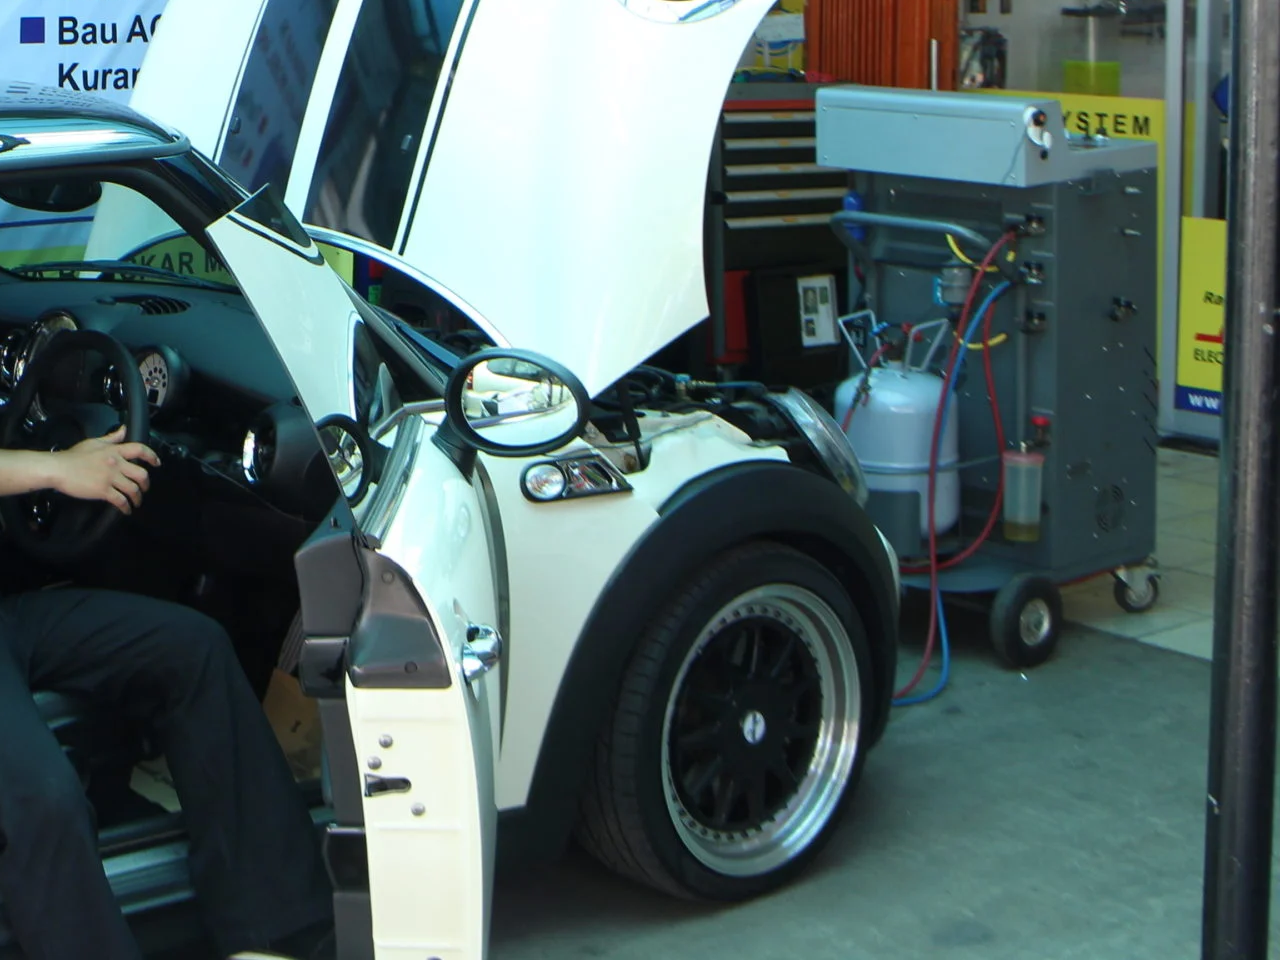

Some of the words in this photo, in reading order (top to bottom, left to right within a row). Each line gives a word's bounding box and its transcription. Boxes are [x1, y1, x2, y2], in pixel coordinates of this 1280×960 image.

[58, 16, 117, 45] Bau
[58, 63, 140, 91] Kura
[1063, 110, 1150, 136] YSTEM
